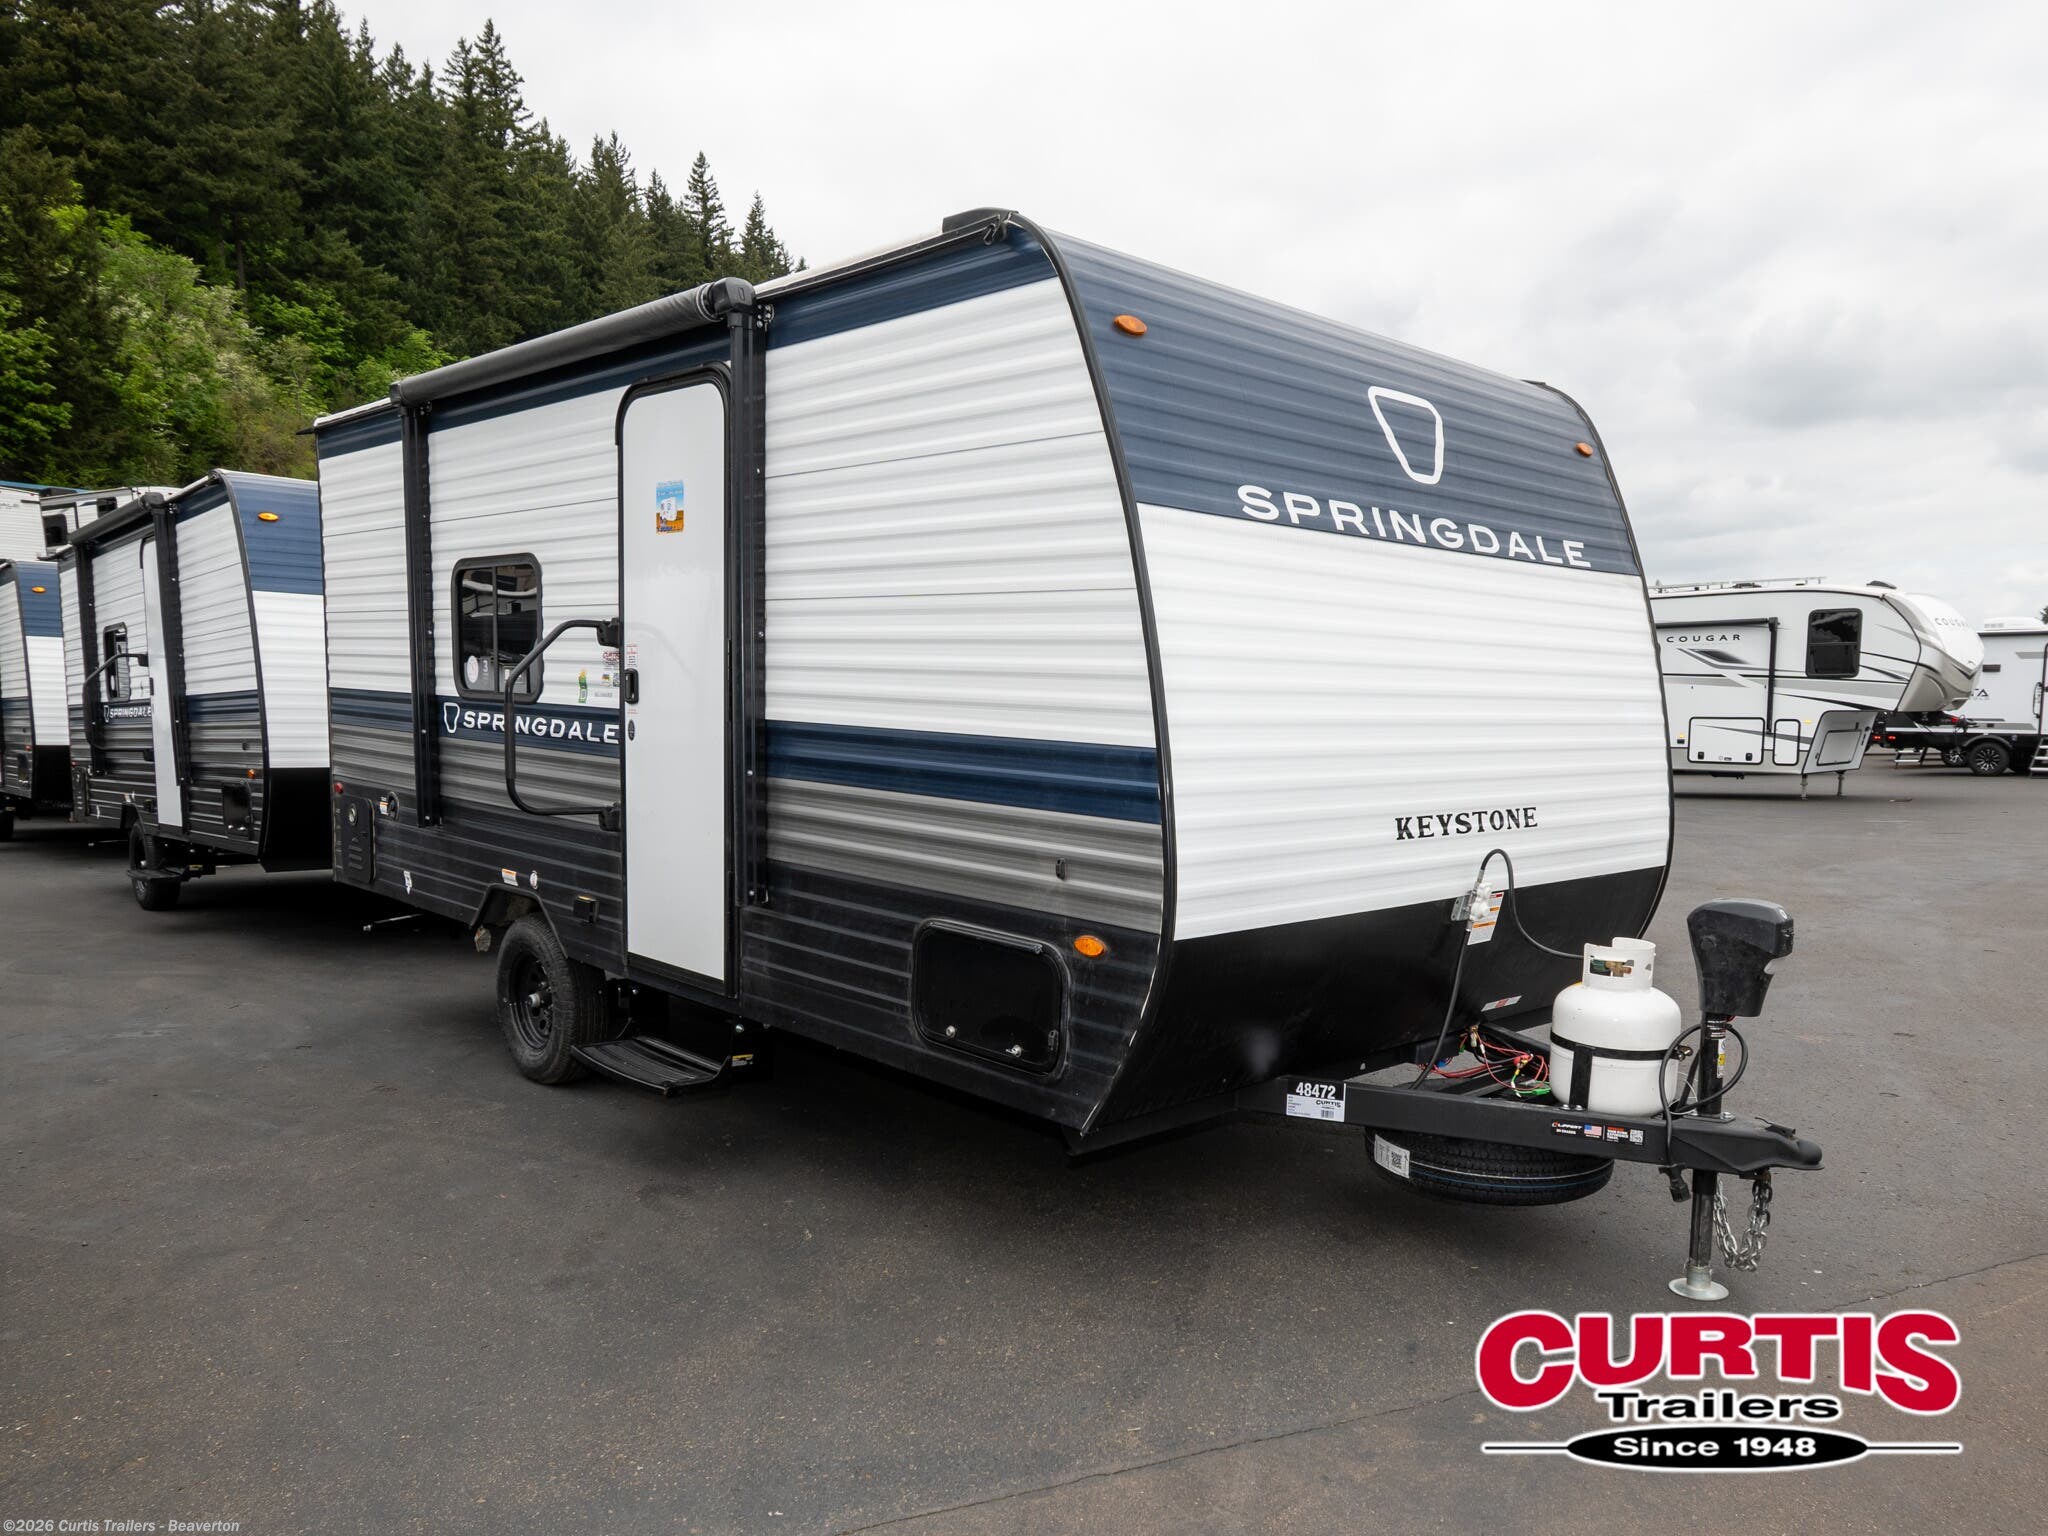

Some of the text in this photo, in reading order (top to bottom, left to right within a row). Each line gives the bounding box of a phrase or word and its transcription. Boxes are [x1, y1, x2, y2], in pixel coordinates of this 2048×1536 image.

[1237, 484, 1592, 568] SPRINGDALE
[1666, 634, 1741, 643] COUGAR
[463, 710, 620, 744] SPRNGDALE
[1395, 806, 1538, 841] KEYSTONE
[1295, 1081, 1336, 1100] 48472
